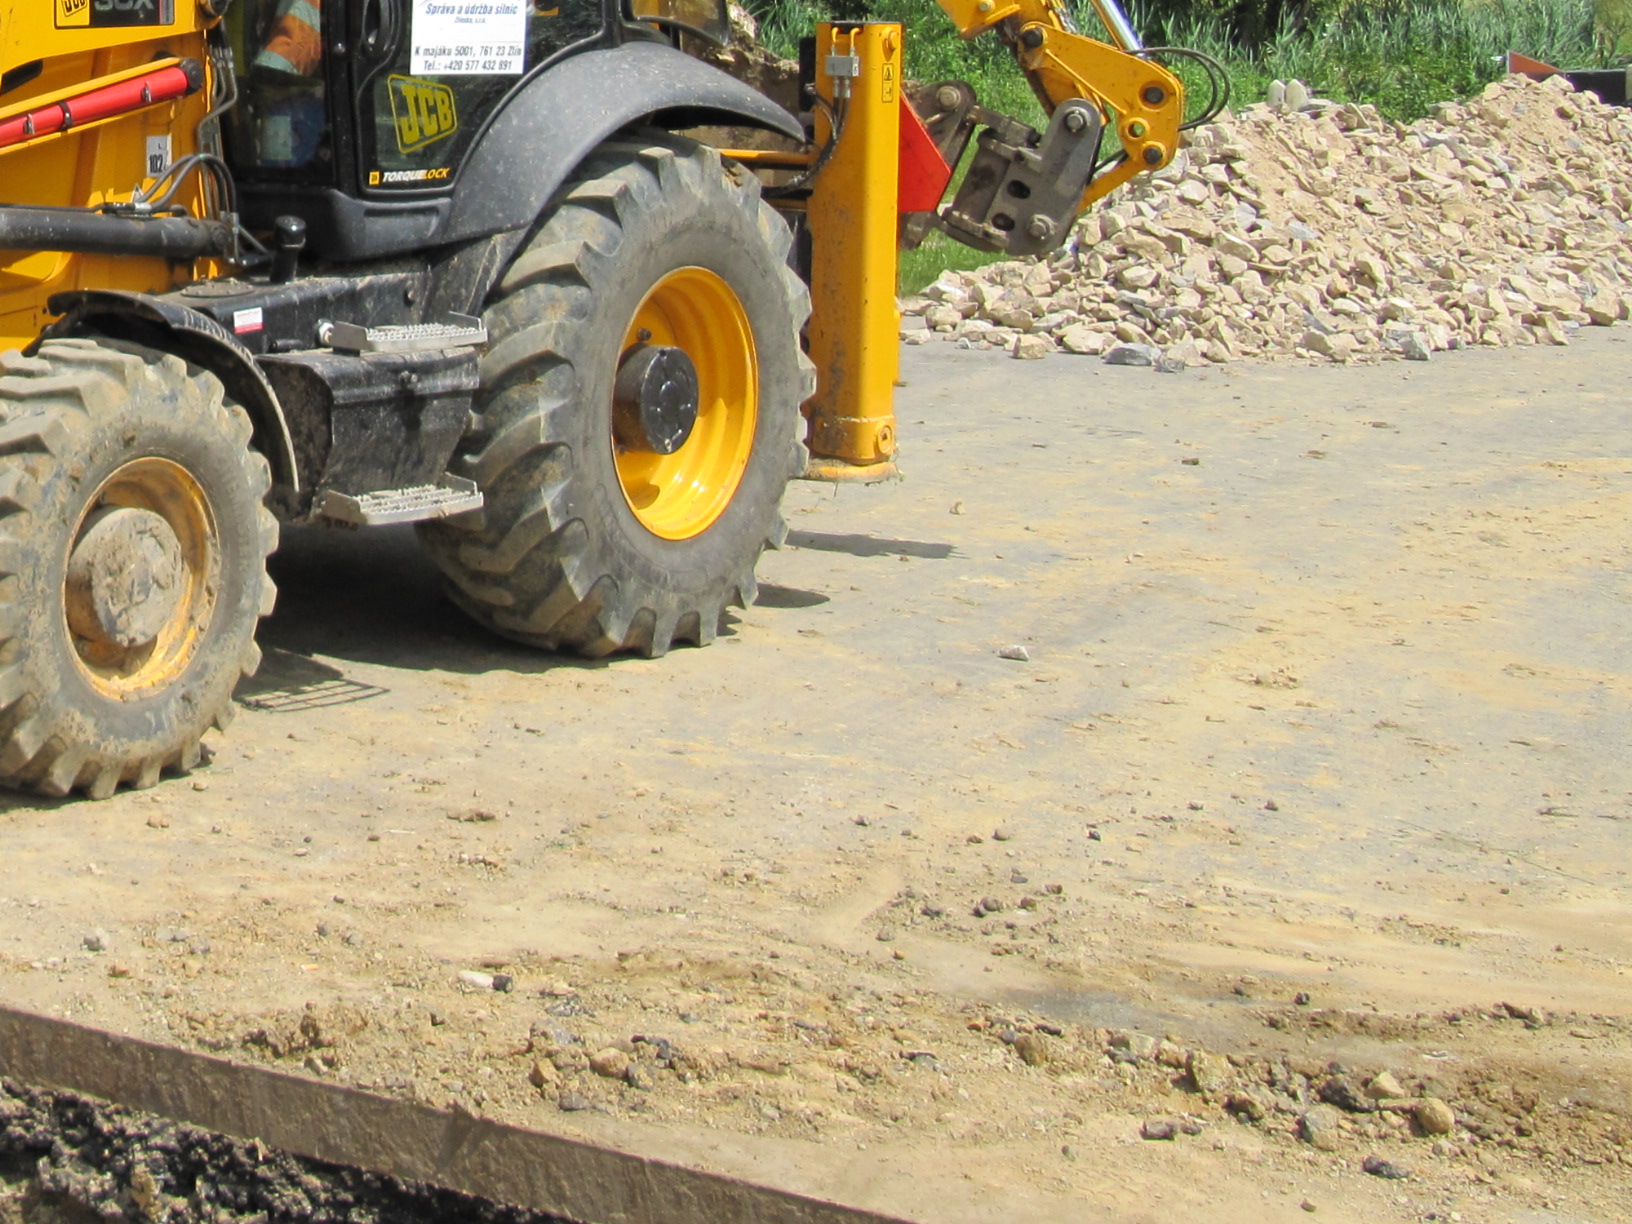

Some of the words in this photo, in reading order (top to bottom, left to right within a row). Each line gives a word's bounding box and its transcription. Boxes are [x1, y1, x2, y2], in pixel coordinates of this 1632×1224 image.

[425, 3, 456, 16] Správa
[457, 6, 464, 15] a
[464, 3, 493, 15] údržba
[494, 3, 518, 15] silnic
[415, 46, 421, 56] K
[423, 45, 452, 58] majáku
[454, 45, 476, 58] 5001,
[480, 45, 493, 56] 761
[496, 45, 506, 56] 23
[507, 45, 522, 56] Zlín
[443, 60, 463, 71] +420
[465, 60, 480, 71] 577
[482, 60, 496, 71] 432
[498, 60, 512, 71] 891
[398, 83, 453, 145] JCB
[149, 154, 164, 173] 102
